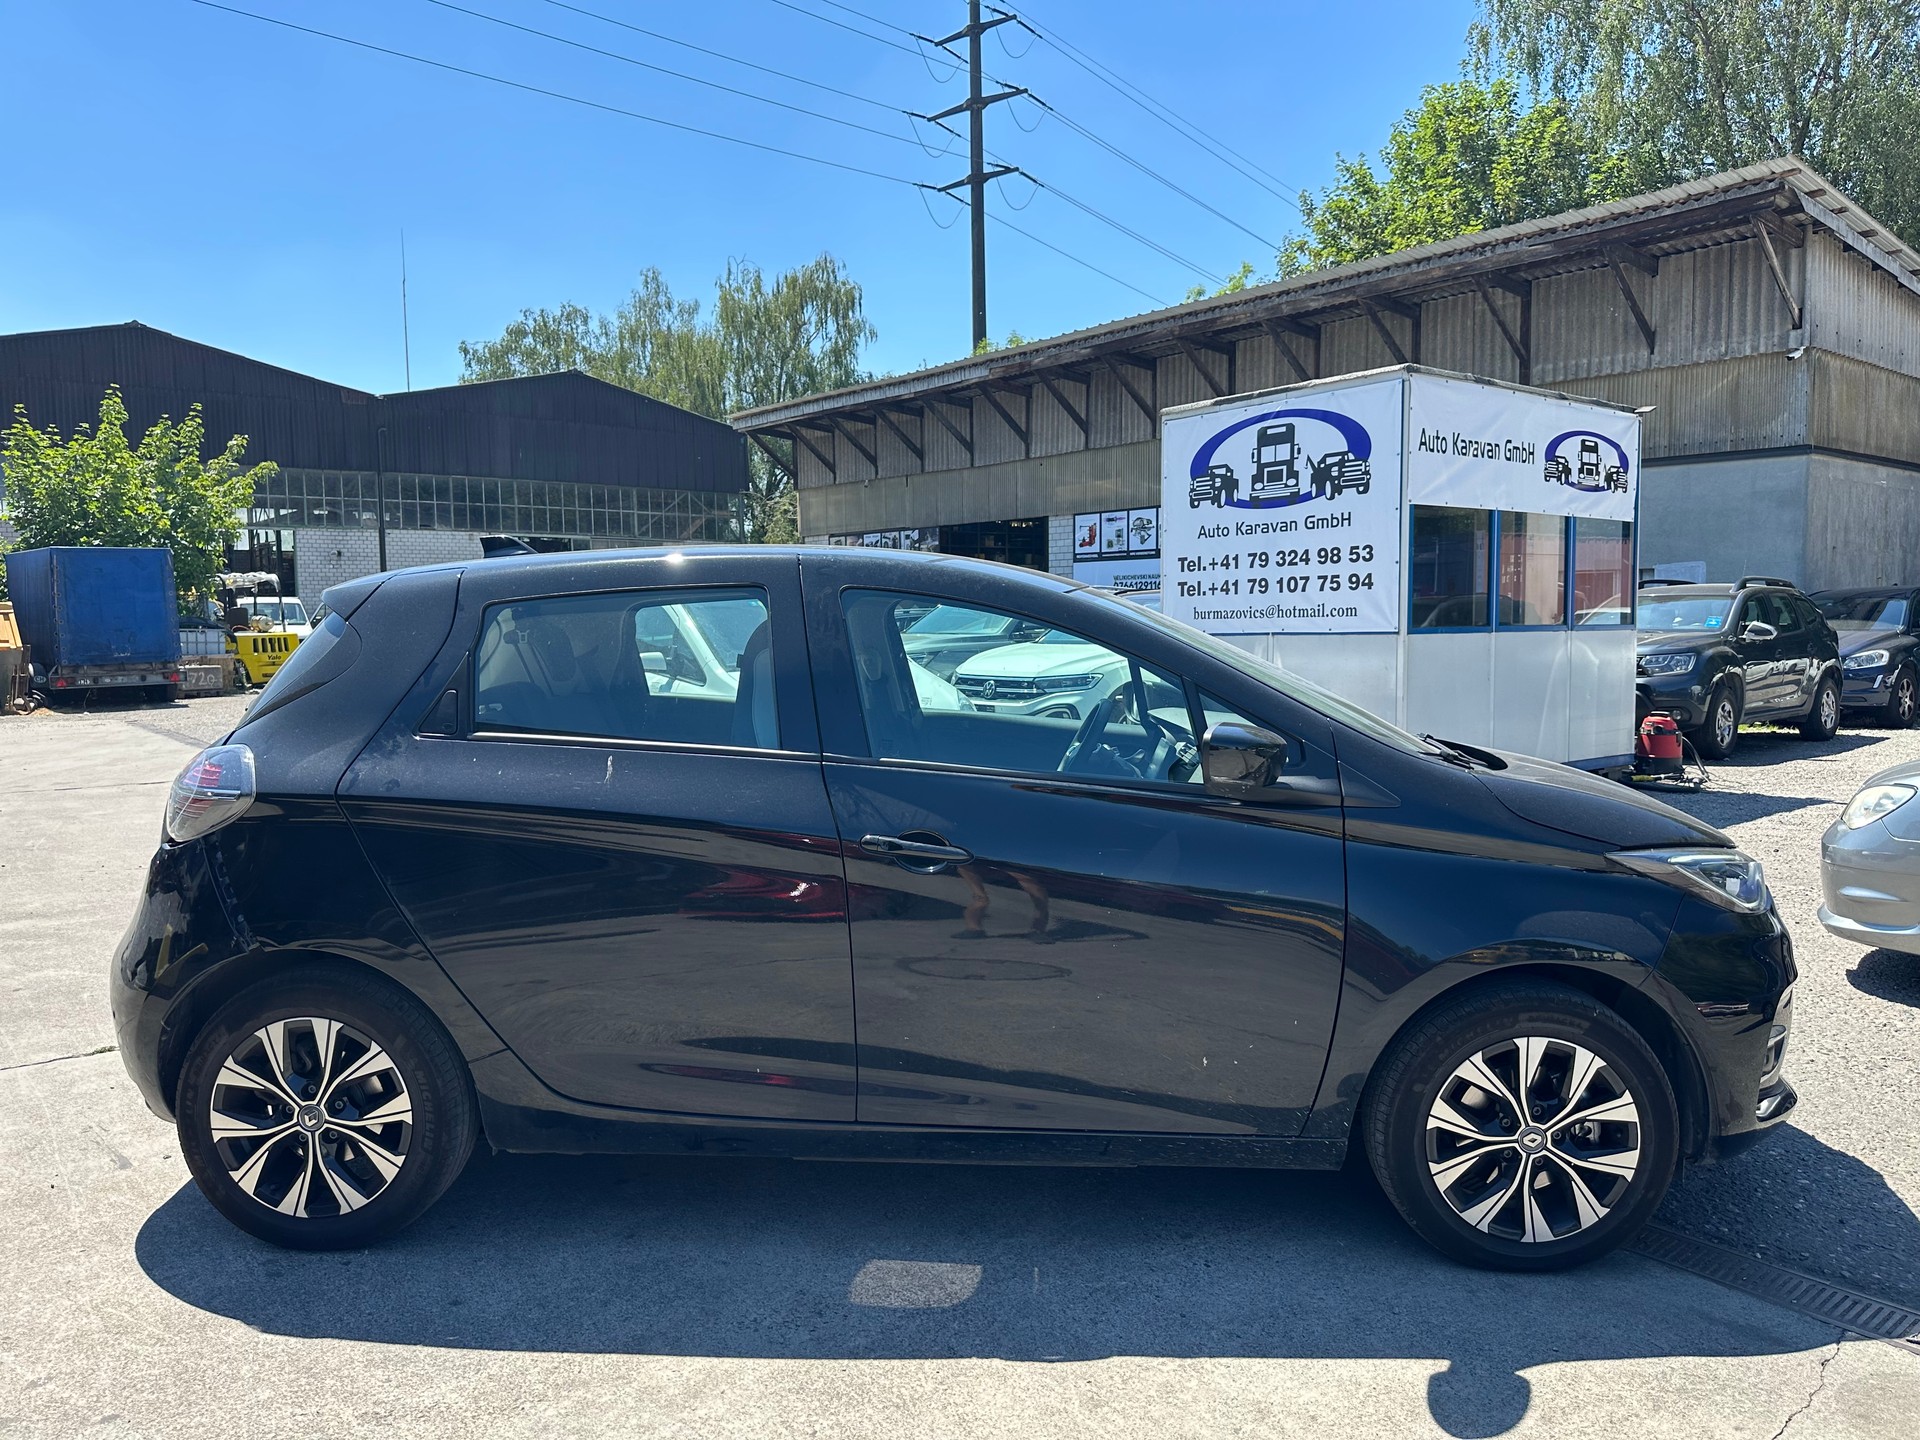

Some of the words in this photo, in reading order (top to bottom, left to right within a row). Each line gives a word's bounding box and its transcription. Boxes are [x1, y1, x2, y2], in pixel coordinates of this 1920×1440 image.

[1418, 428, 1447, 454] Auto
[1452, 432, 1500, 460] Karavan
[1504, 439, 1535, 464] GmbH
[1198, 523, 1230, 539] Auto
[1235, 518, 1298, 536] Karavan
[1304, 512, 1352, 530] GmbH
[1178, 553, 1240, 572] Tel.+41
[1248, 552, 1270, 568] 79
[1275, 549, 1310, 567] 324
[1317, 546, 1342, 565] 98
[1348, 544, 1374, 563] 53
[1178, 578, 1240, 597] Tel.+41
[1248, 578, 1270, 594] 79
[1276, 576, 1310, 593] 107
[1317, 574, 1342, 592] 75
[1348, 572, 1374, 591] 94
[1193, 603, 1358, 620] burmazovics@hotmail.com
